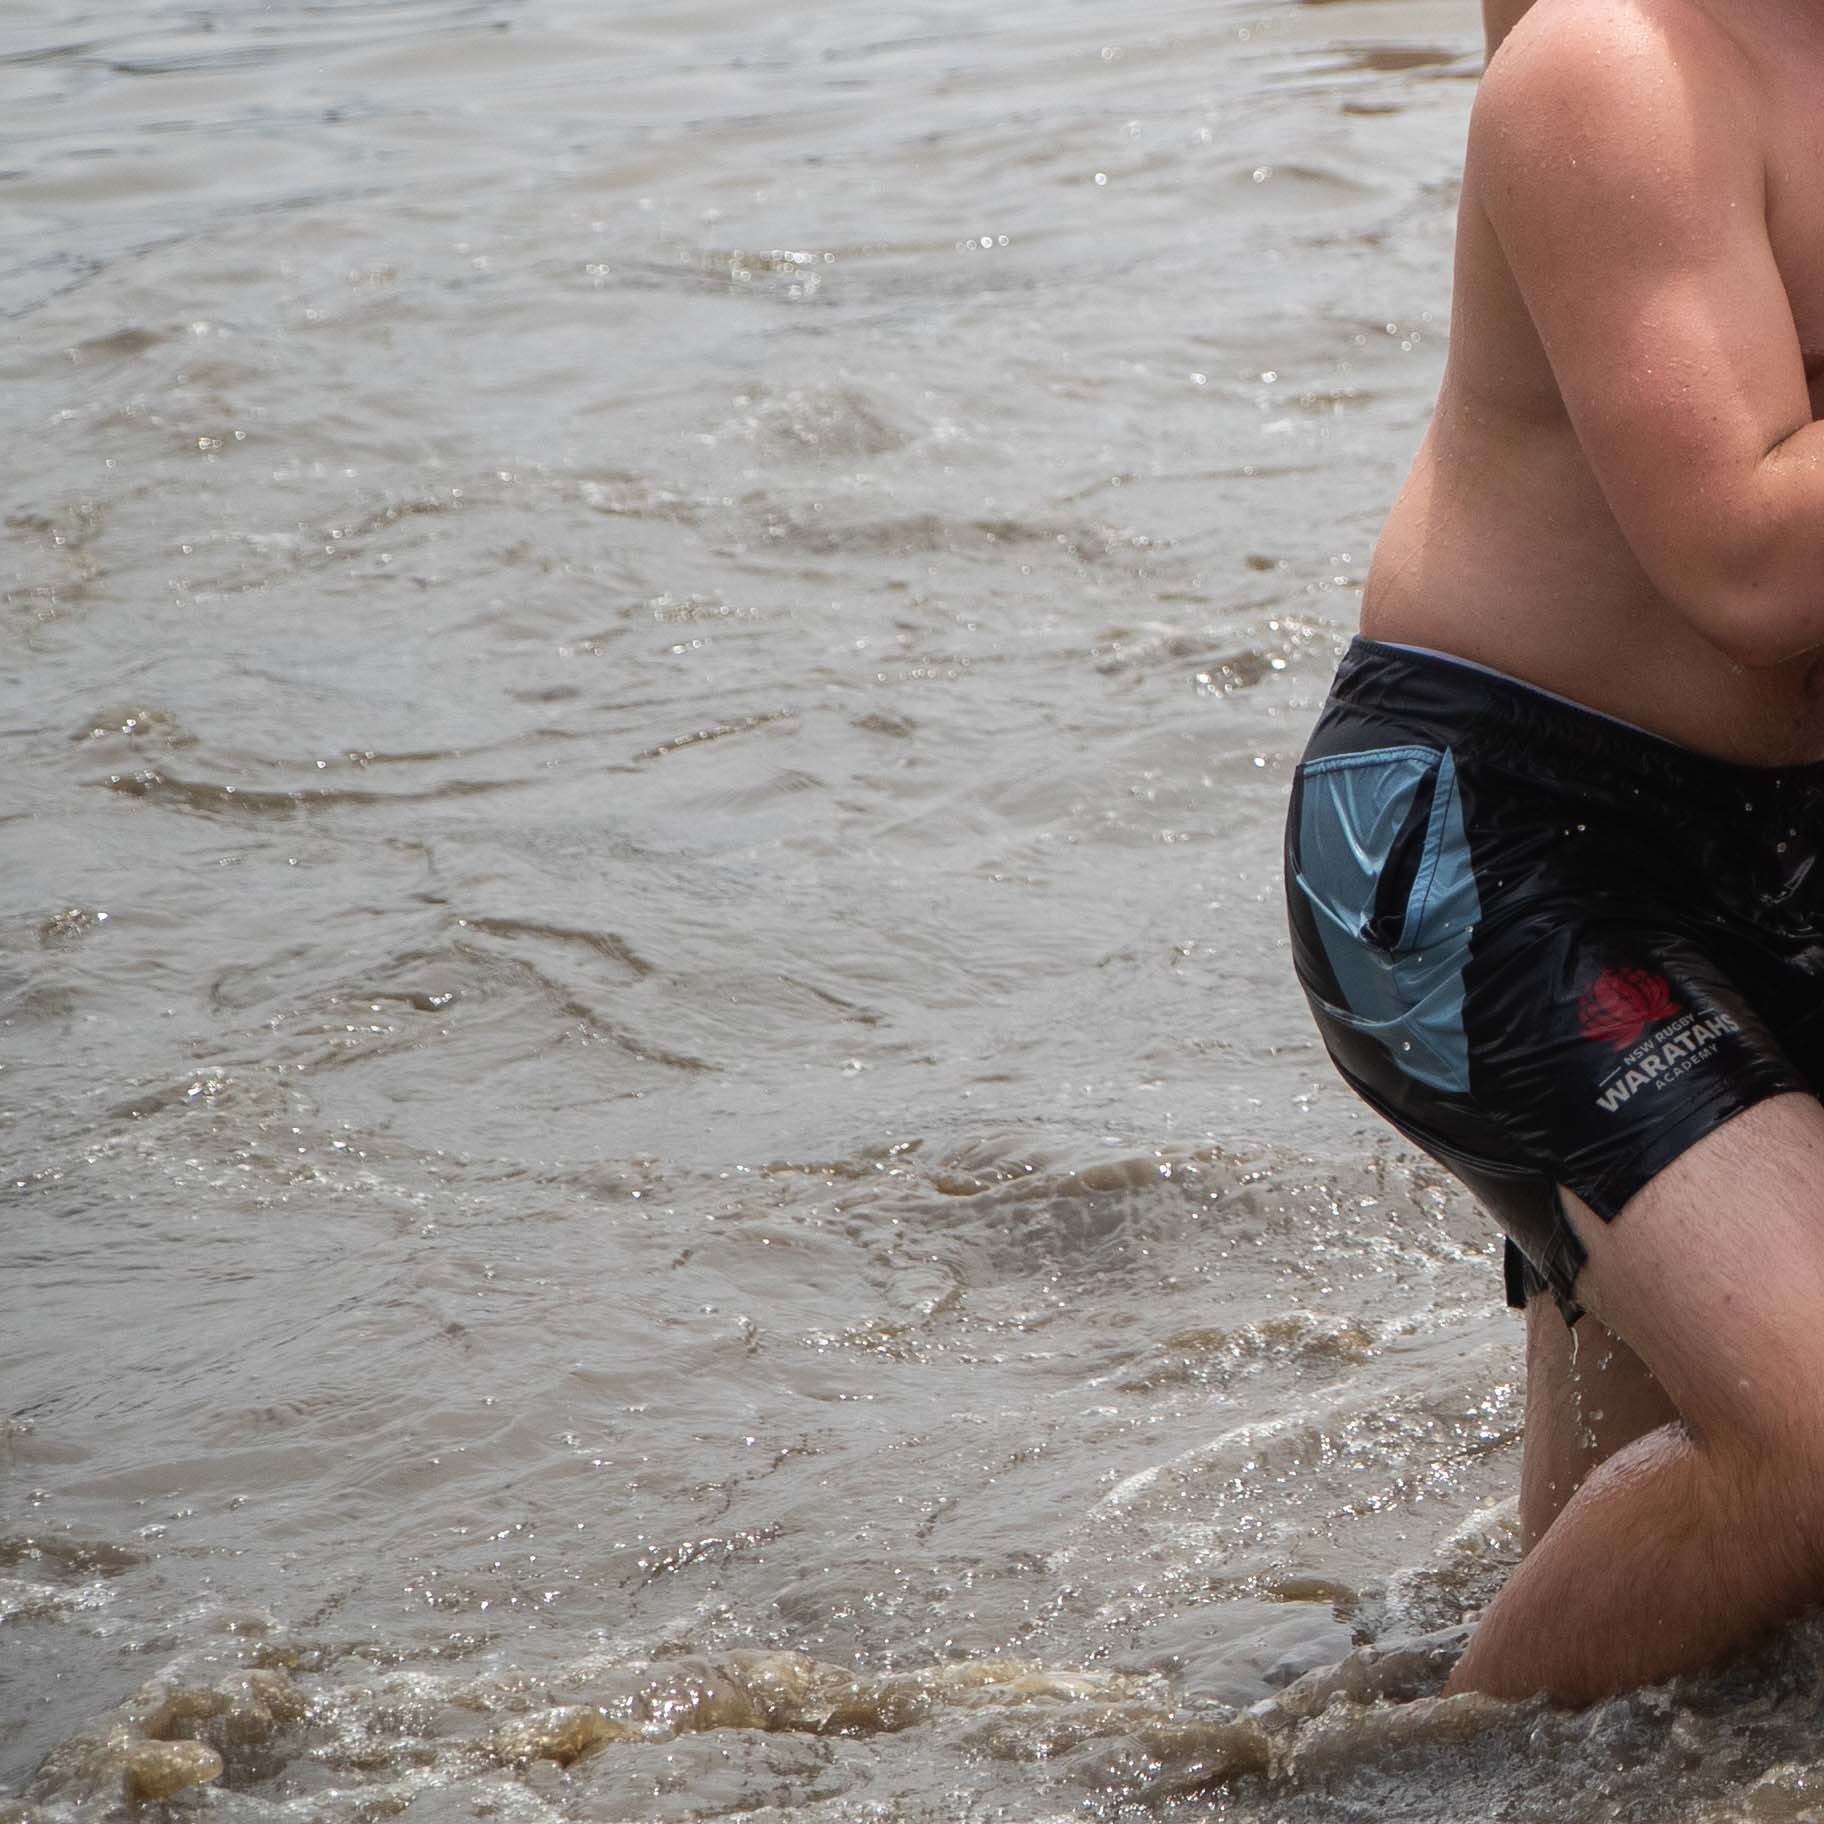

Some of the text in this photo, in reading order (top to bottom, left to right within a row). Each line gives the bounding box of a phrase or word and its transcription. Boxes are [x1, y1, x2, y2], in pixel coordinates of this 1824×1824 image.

[1596, 1013, 1741, 1113] WARATAHS
[1624, 1013, 1696, 1067] NSW RUGBY
[1655, 1043, 1718, 1090] ACADEMY
